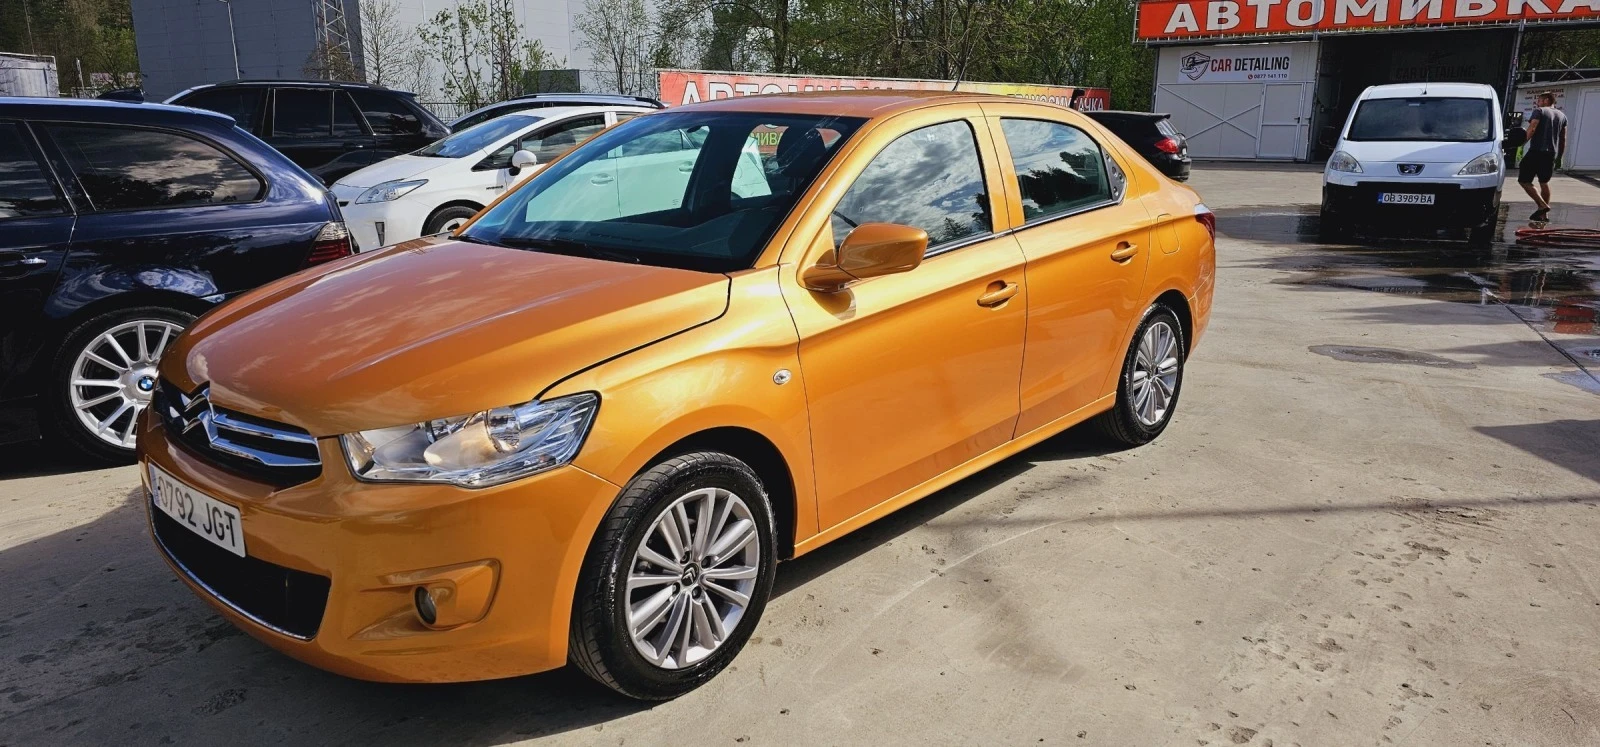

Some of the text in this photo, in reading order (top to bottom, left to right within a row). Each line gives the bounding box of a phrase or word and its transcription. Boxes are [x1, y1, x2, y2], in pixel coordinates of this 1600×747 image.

[1211, 57, 1290, 72] CAR DETAILING
[1397, 195, 1419, 203] 3989
[158, 476, 236, 547] 0792 JGT
